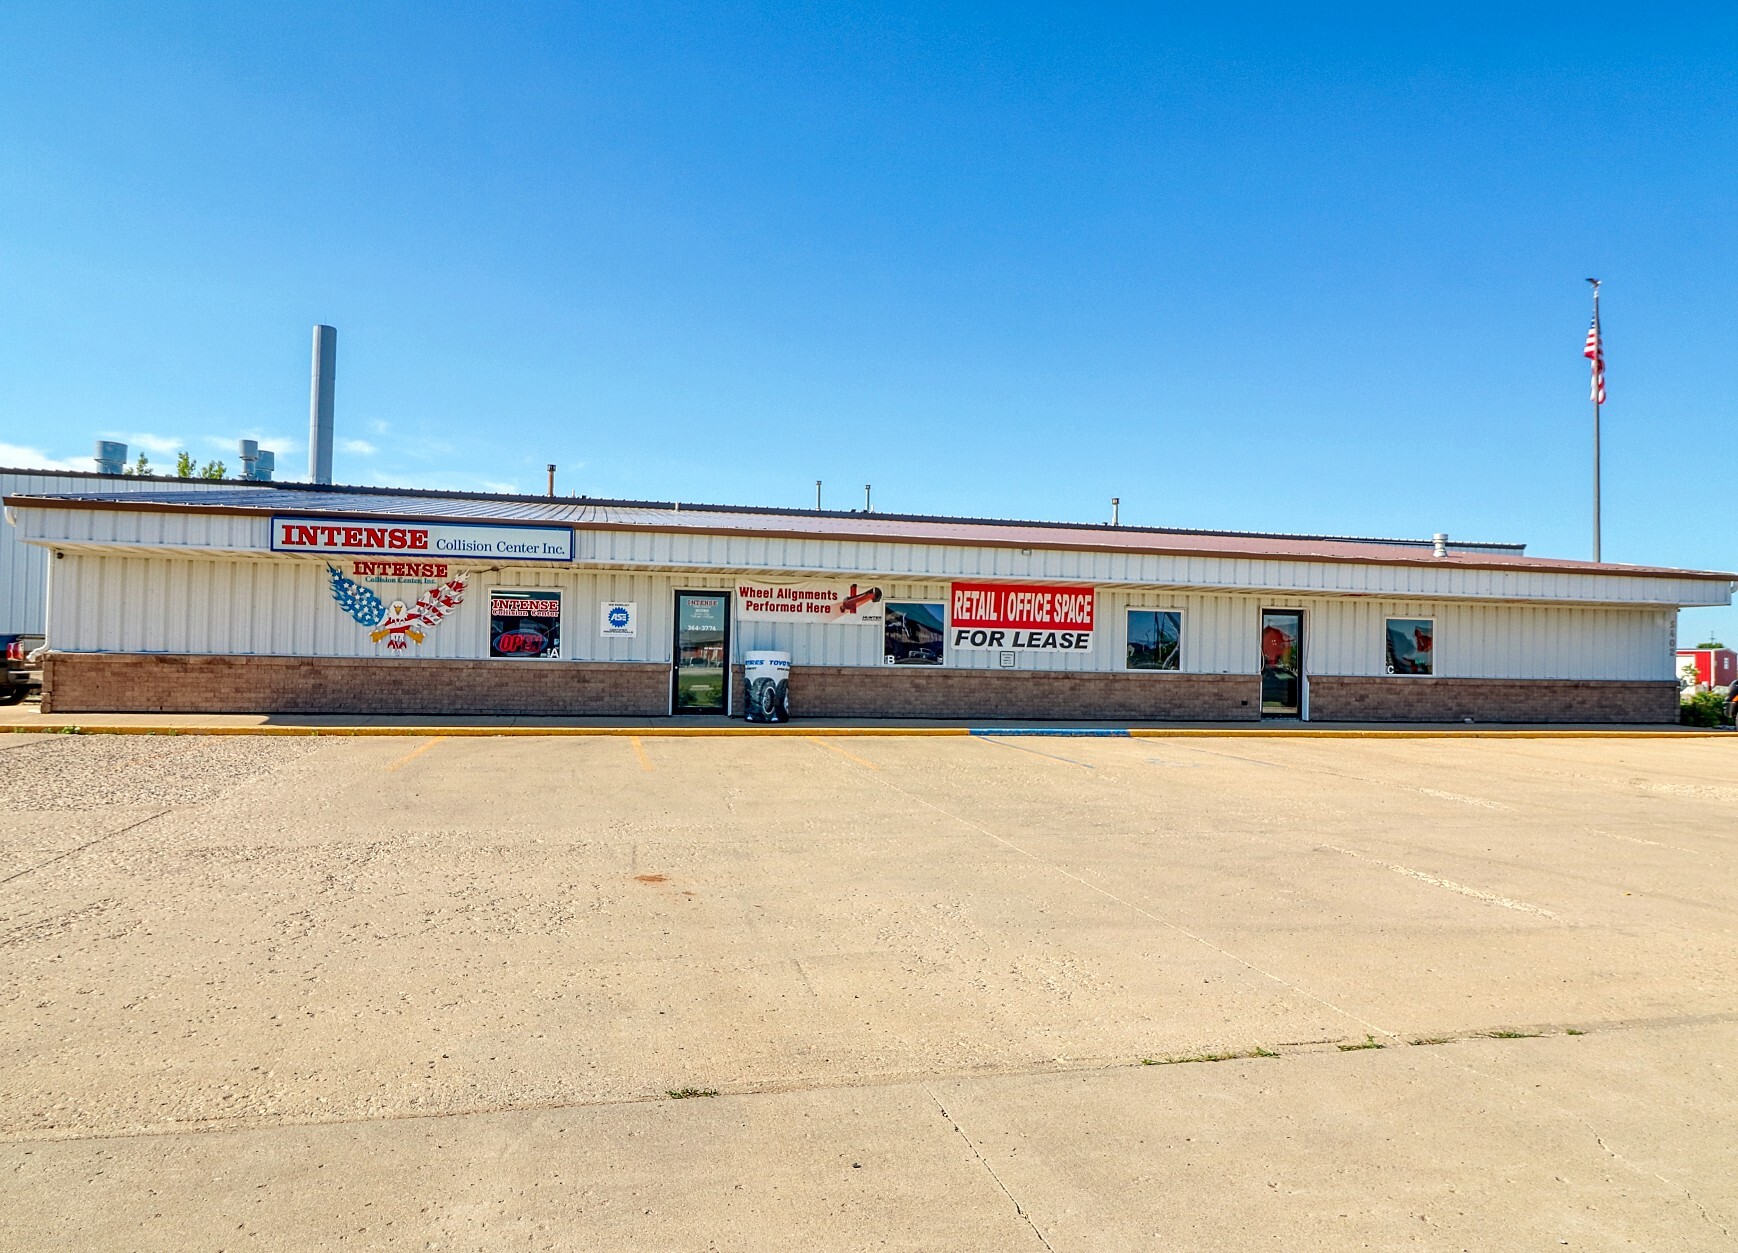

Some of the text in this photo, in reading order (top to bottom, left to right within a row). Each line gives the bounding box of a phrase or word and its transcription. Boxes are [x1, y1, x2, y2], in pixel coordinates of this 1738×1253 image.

[281, 524, 565, 555] INTENSE Collision Center Inc.
[353, 561, 448, 578] INTENSE
[739, 586, 838, 602] Wheel Alignments
[491, 599, 560, 611] INTENSE
[746, 601, 831, 614] Performed Here
[953, 590, 998, 621] RETAIL
[1007, 592, 1052, 622] OFFICE
[1053, 593, 1092, 624] SPACE
[610, 613, 627, 621] ASE
[954, 630, 1090, 649] FOR LEASE
[550, 648, 559, 658] A
[887, 655, 895, 665] B
[1387, 665, 1395, 674] C
